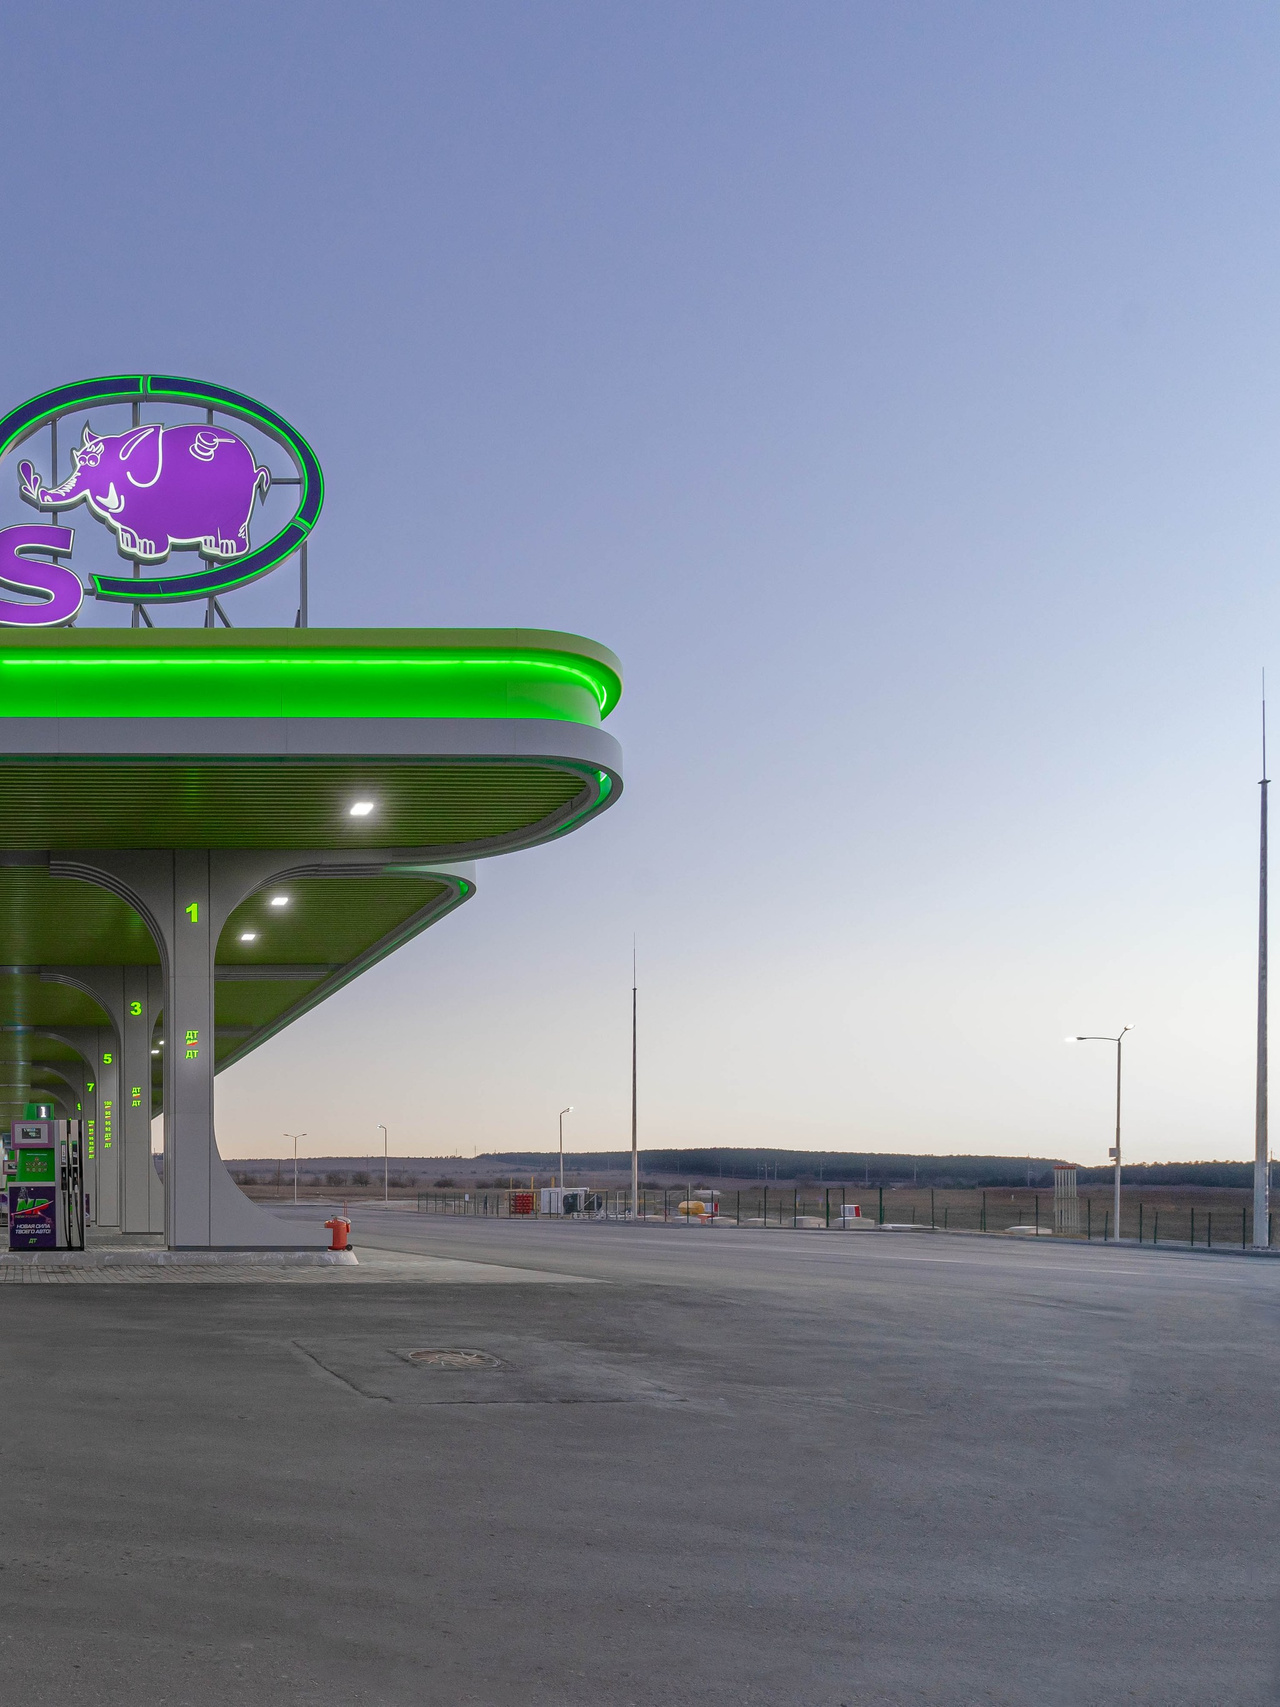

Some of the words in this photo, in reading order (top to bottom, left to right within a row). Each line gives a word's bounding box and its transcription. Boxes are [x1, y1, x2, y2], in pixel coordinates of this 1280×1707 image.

[185, 902, 199, 923] 1
[130, 1001, 142, 1016] 3
[185, 1030, 199, 1040] ДТ
[103, 1053, 113, 1065] 5
[185, 1049, 199, 1059] ДТ
[86, 1082, 95, 1092] 7
[40, 1106, 47, 1118] 1
